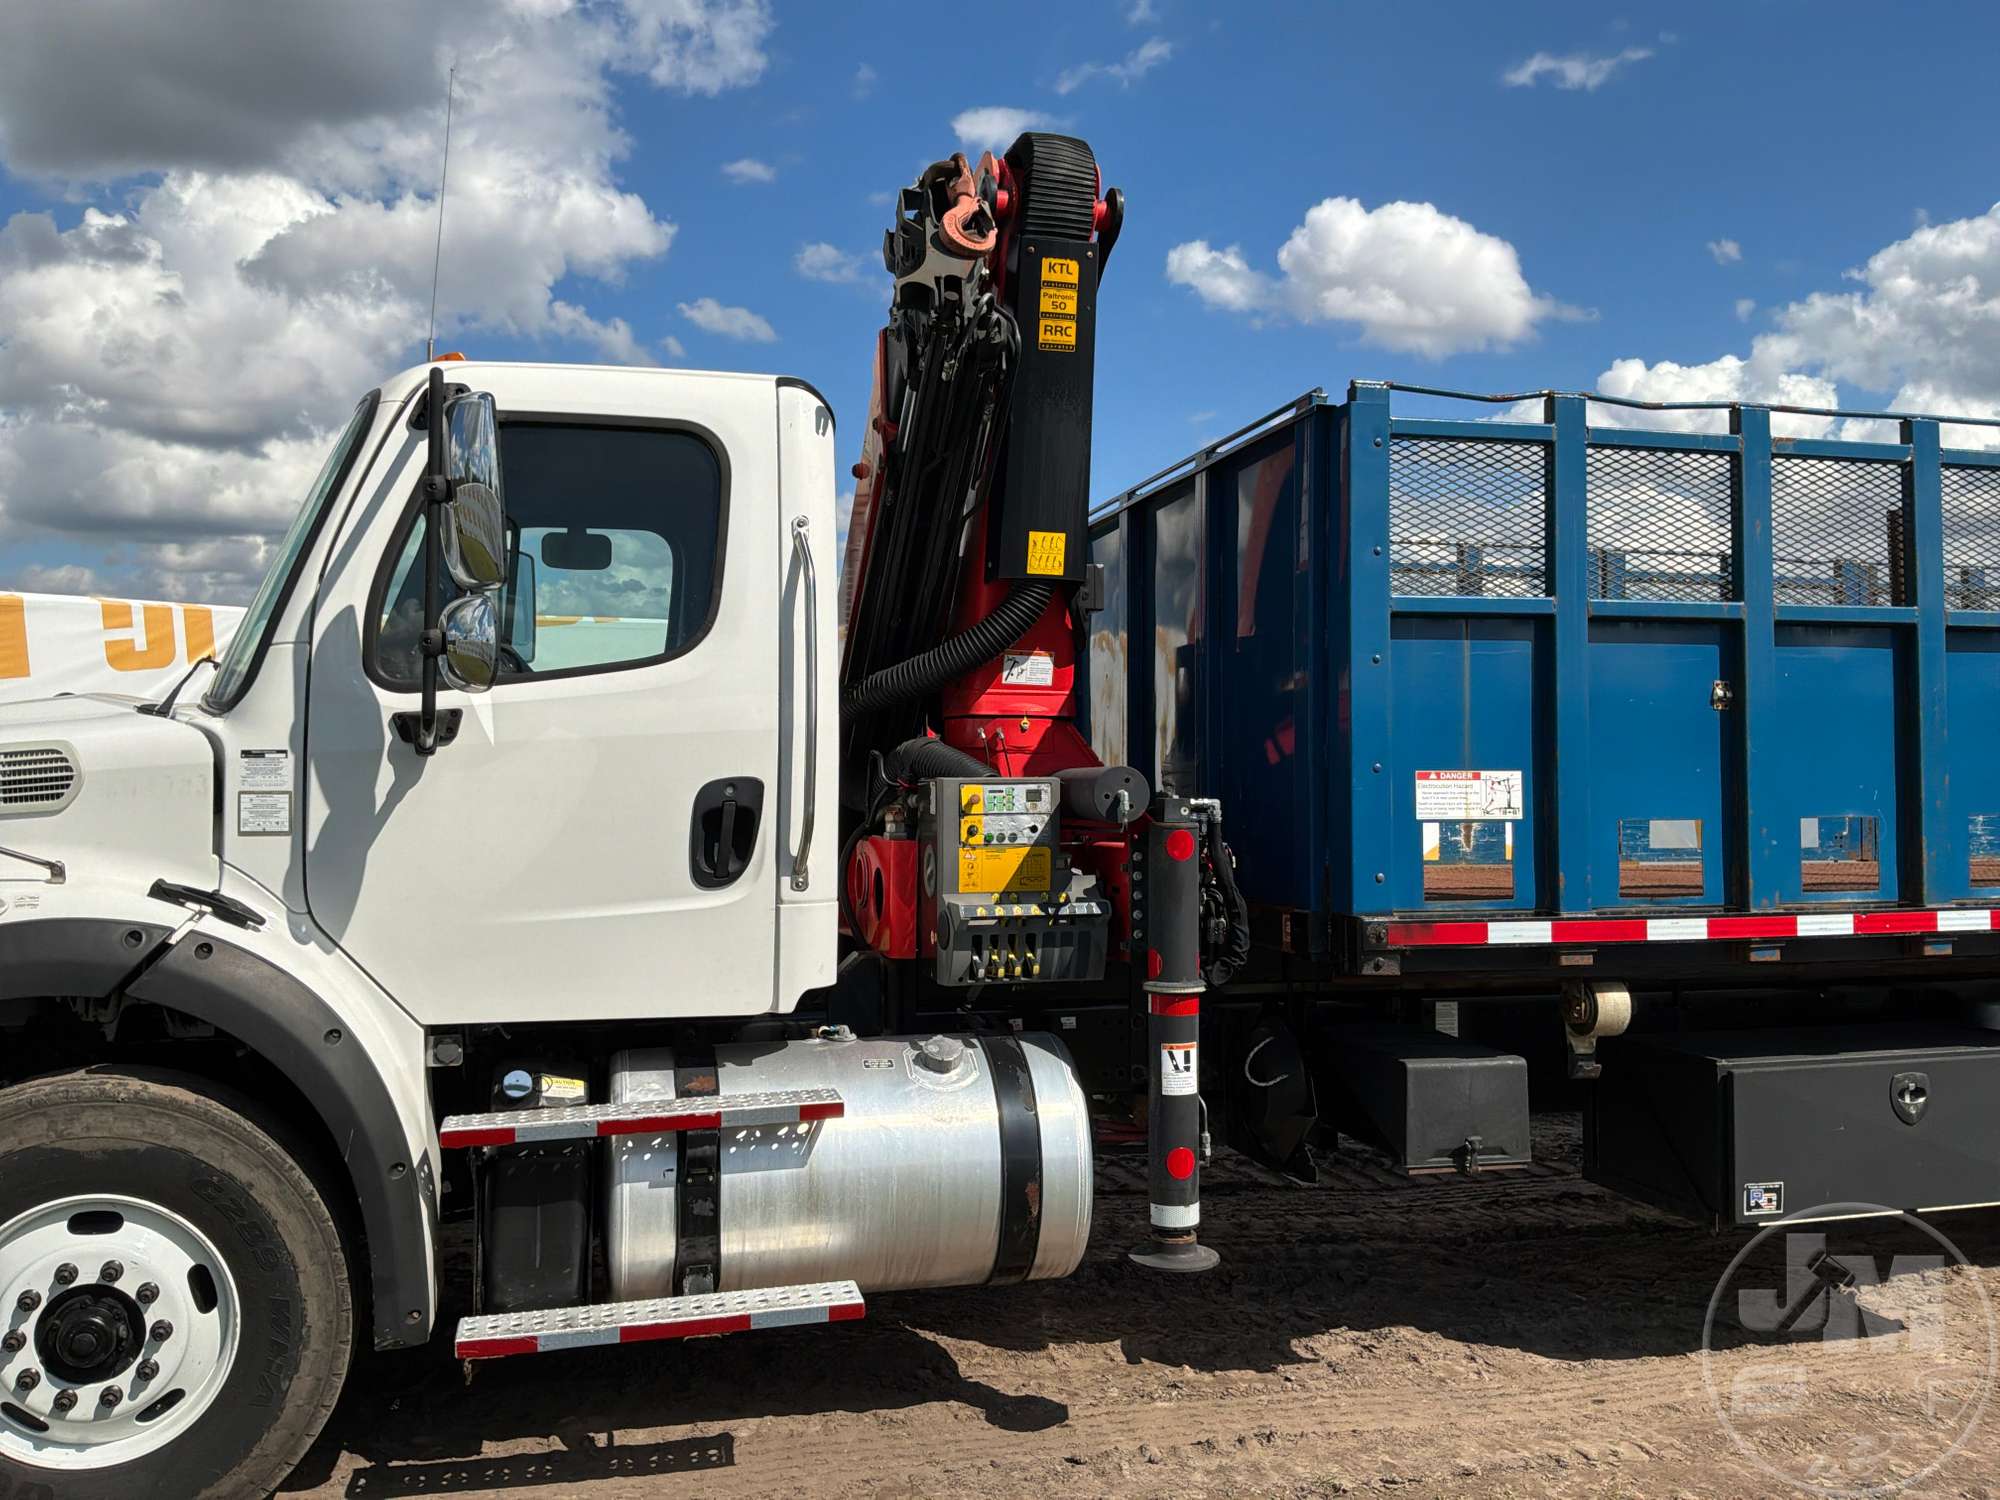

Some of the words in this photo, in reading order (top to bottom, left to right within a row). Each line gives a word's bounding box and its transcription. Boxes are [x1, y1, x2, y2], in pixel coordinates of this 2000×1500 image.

[1048, 262, 1073, 276] KTL
[1043, 292, 1075, 301] Paltronic
[1051, 301, 1067, 311] 50
[1043, 324, 1073, 337] RRC
